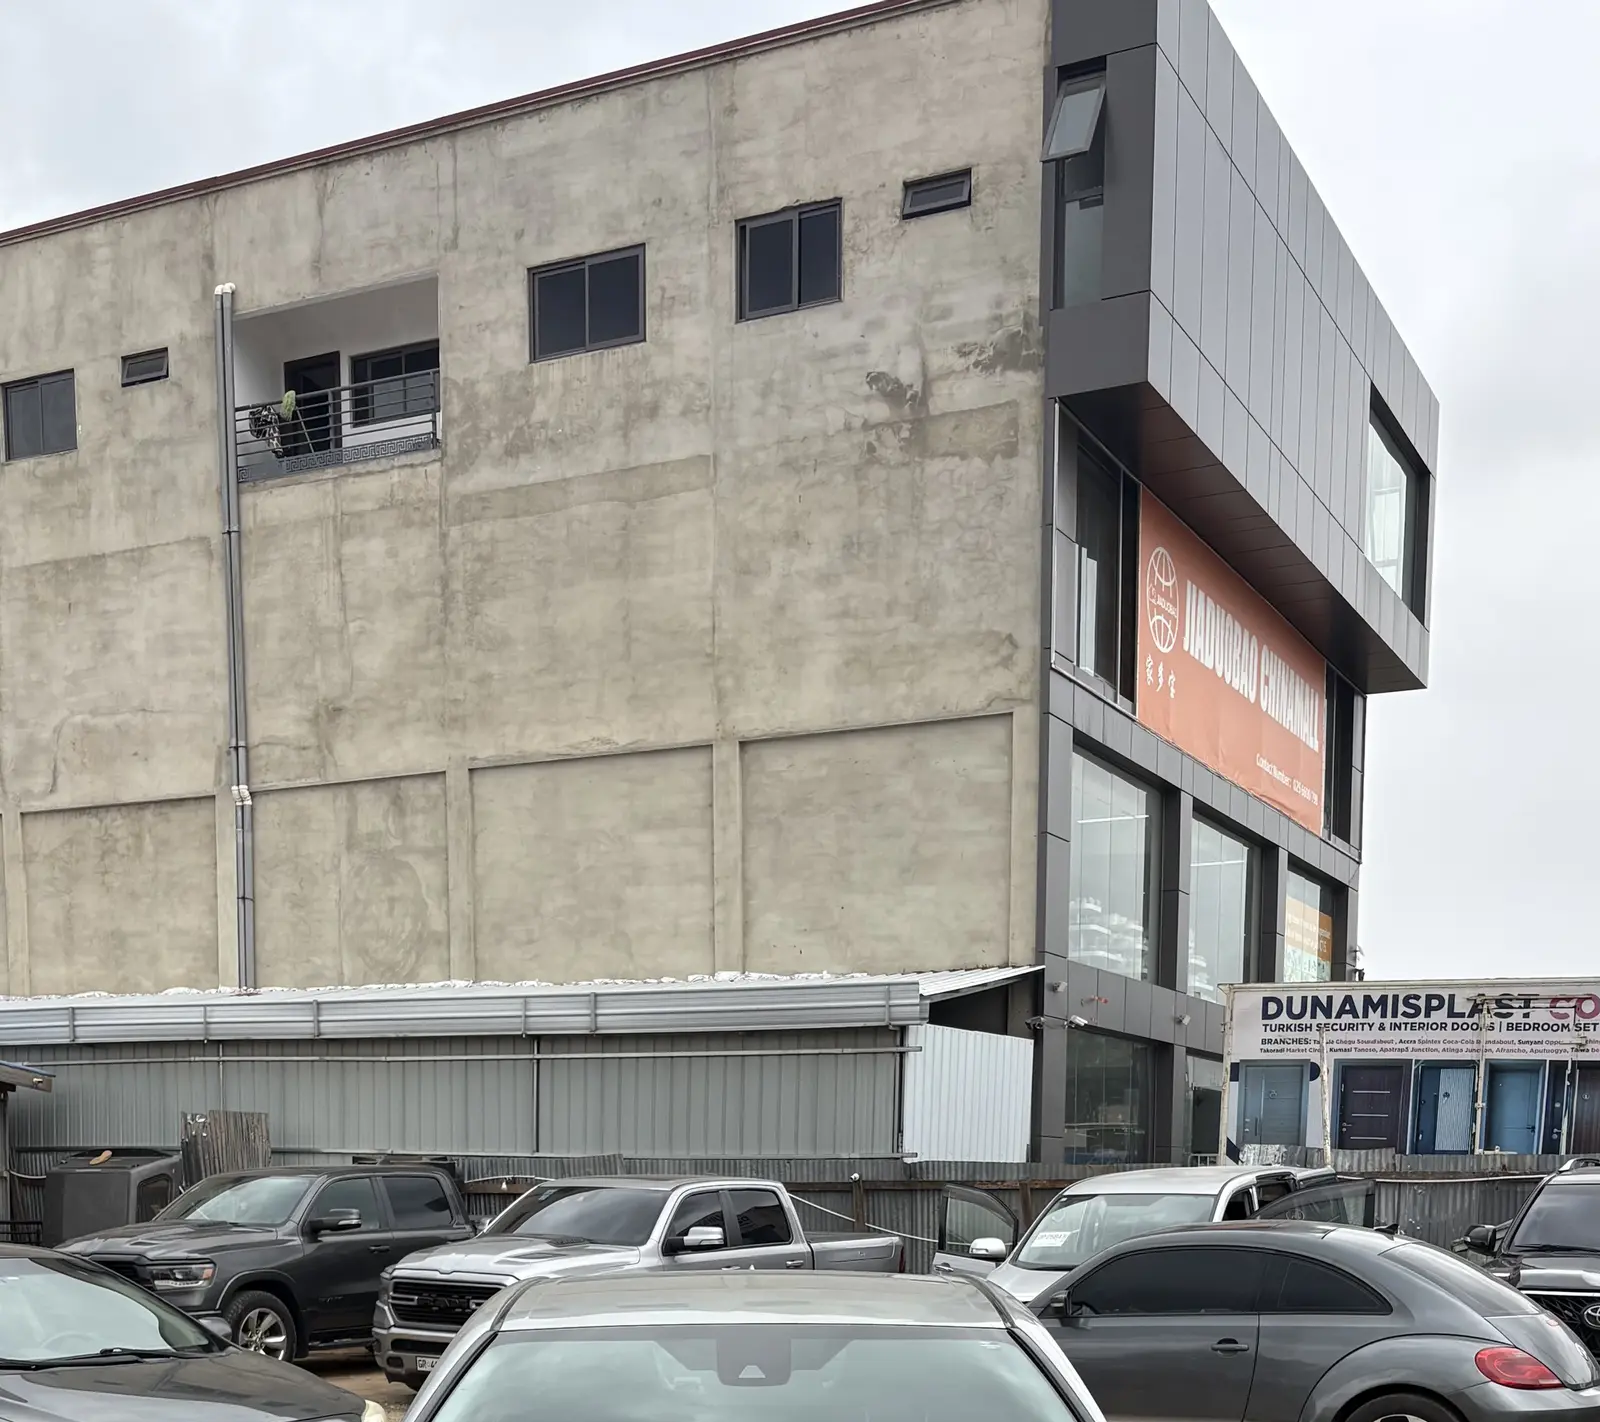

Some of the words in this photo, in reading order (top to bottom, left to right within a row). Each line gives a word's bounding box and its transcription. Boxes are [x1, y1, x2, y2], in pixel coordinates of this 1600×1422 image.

[1183, 579, 1259, 704] JIADUOBAO
[1260, 644, 1319, 753] CHINAMALL
[1261, 993, 1540, 1021] DUNAMISPLAST
[1262, 1023, 1312, 1033] TURKISH
[1316, 1022, 1375, 1032] SECURITY
[1378, 1022, 1386, 1032] &
[1389, 1021, 1448, 1032] INTERIOR
[1451, 1021, 1495, 1032] DOOS
[1506, 1022, 1571, 1032] BEDROOM
[1260, 1037, 1312, 1046] BRANCHES:
